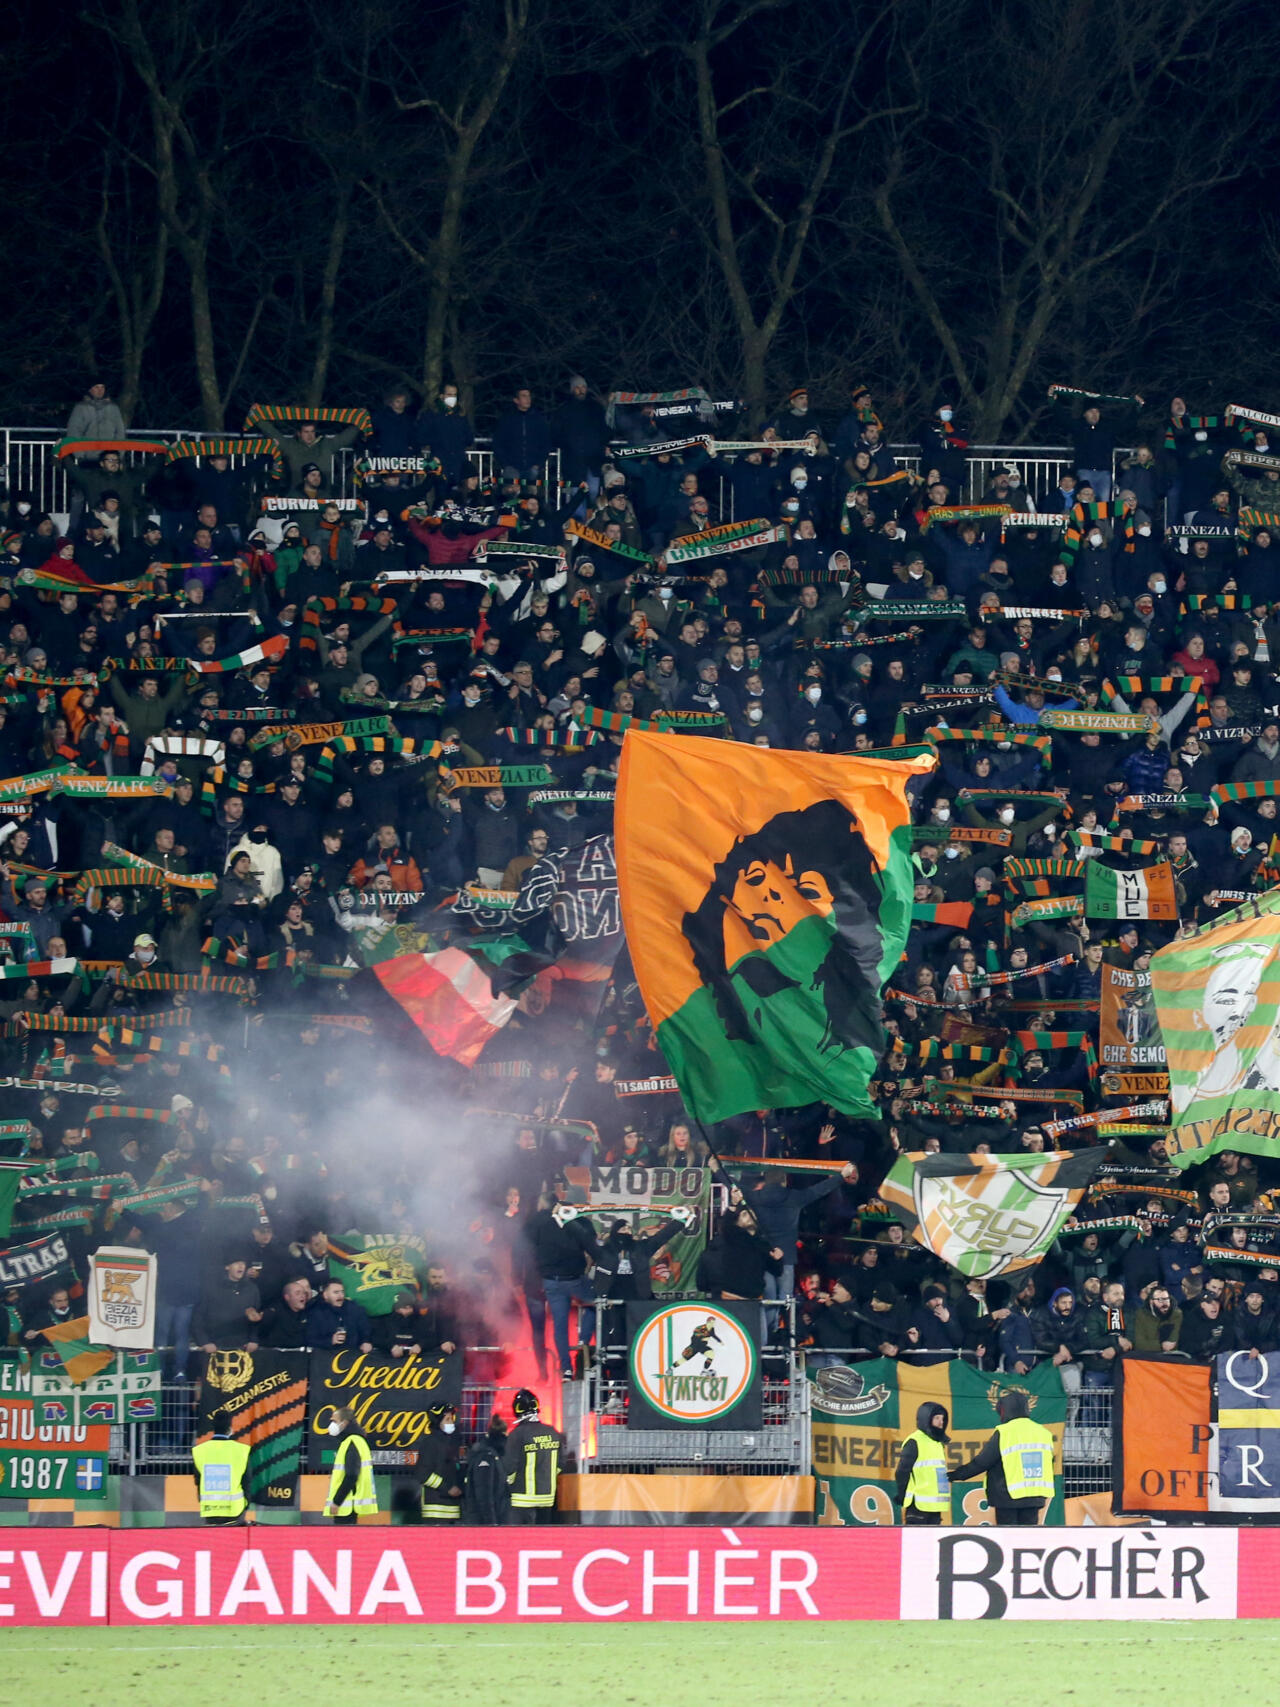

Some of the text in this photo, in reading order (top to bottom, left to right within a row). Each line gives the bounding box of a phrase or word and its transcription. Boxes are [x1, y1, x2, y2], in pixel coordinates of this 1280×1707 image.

[654, 404, 694, 416] VENEZIA
[367, 457, 425, 471] VINCERE
[267, 498, 358, 511] CURVA UD
[1173, 525, 1230, 537] VENEZIA
[302, 717, 386, 741] VENEZIA FC
[1084, 715, 1138, 730] VENEZIA
[457, 766, 546, 783] VENEZIA FC
[67, 779, 149, 793] VENEZIA FC
[1128, 793, 1187, 804] VENEZIA
[1111, 970, 1135, 987] CHE
[1103, 1045, 1167, 1063] CHE SEMO
[617, 1081, 626, 1093] TI
[1100, 1123, 1148, 1135] ULTRAS
[589, 1166, 704, 1198] MODO
[1225, 1350, 1271, 1399] Q
[664, 1375, 729, 1401] VMFC87
[42, 1397, 157, 1421] RAS
[841, 1398, 877, 1412] MANIERE
[533, 1435, 552, 1444] VIGILI
[9, 1456, 69, 1490] 1987
[1236, 1445, 1272, 1487] R
[267, 1485, 293, 1499] NA9
[0, 1527, 821, 1619] EVIGIANA BECHÈR
[936, 1530, 1210, 1620] BECHÈR
